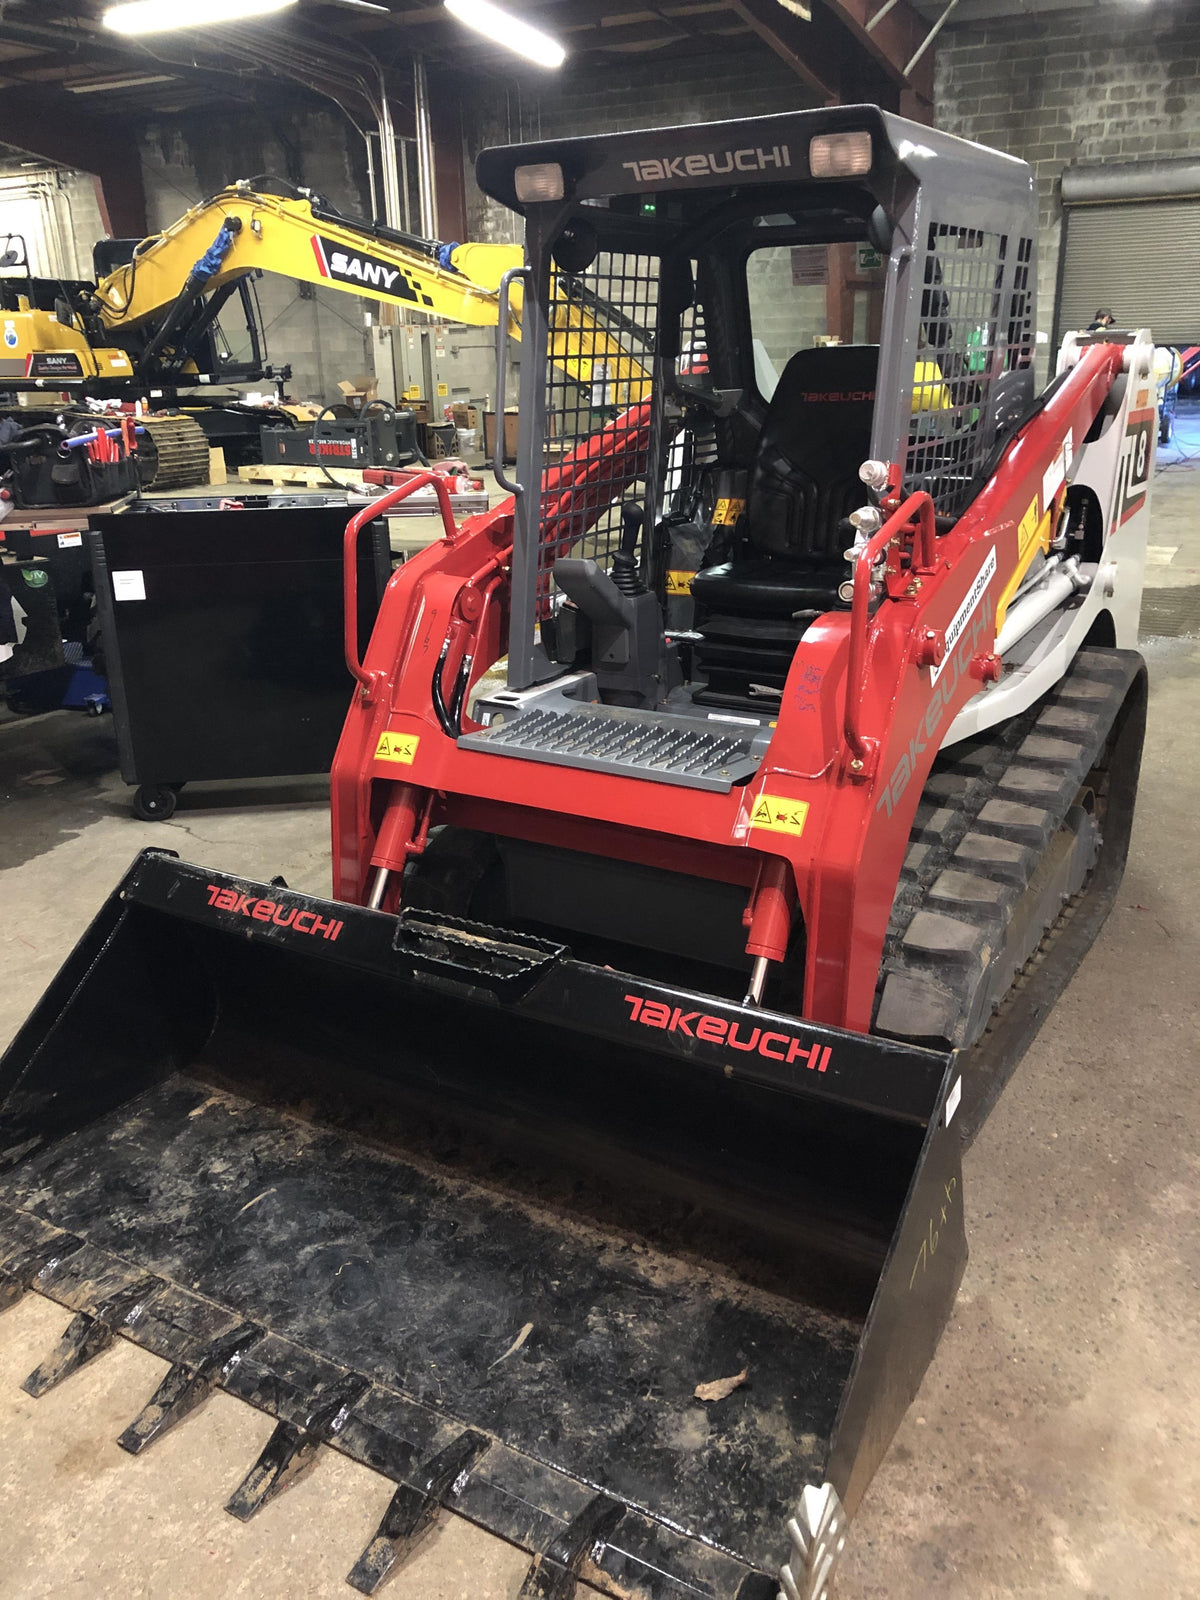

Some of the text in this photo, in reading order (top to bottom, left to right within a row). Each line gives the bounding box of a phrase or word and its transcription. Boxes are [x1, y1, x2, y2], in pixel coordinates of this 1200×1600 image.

[622, 145, 792, 182] TAKEUCHI
[330, 252, 400, 289] SANY
[46, 357, 67, 365] SANY
[935, 557, 996, 674] quipmentShare
[877, 592, 992, 818] TAKEUCHI
[207, 885, 344, 941] TAKEUCHI
[624, 994, 832, 1073] TAKEUCHI
